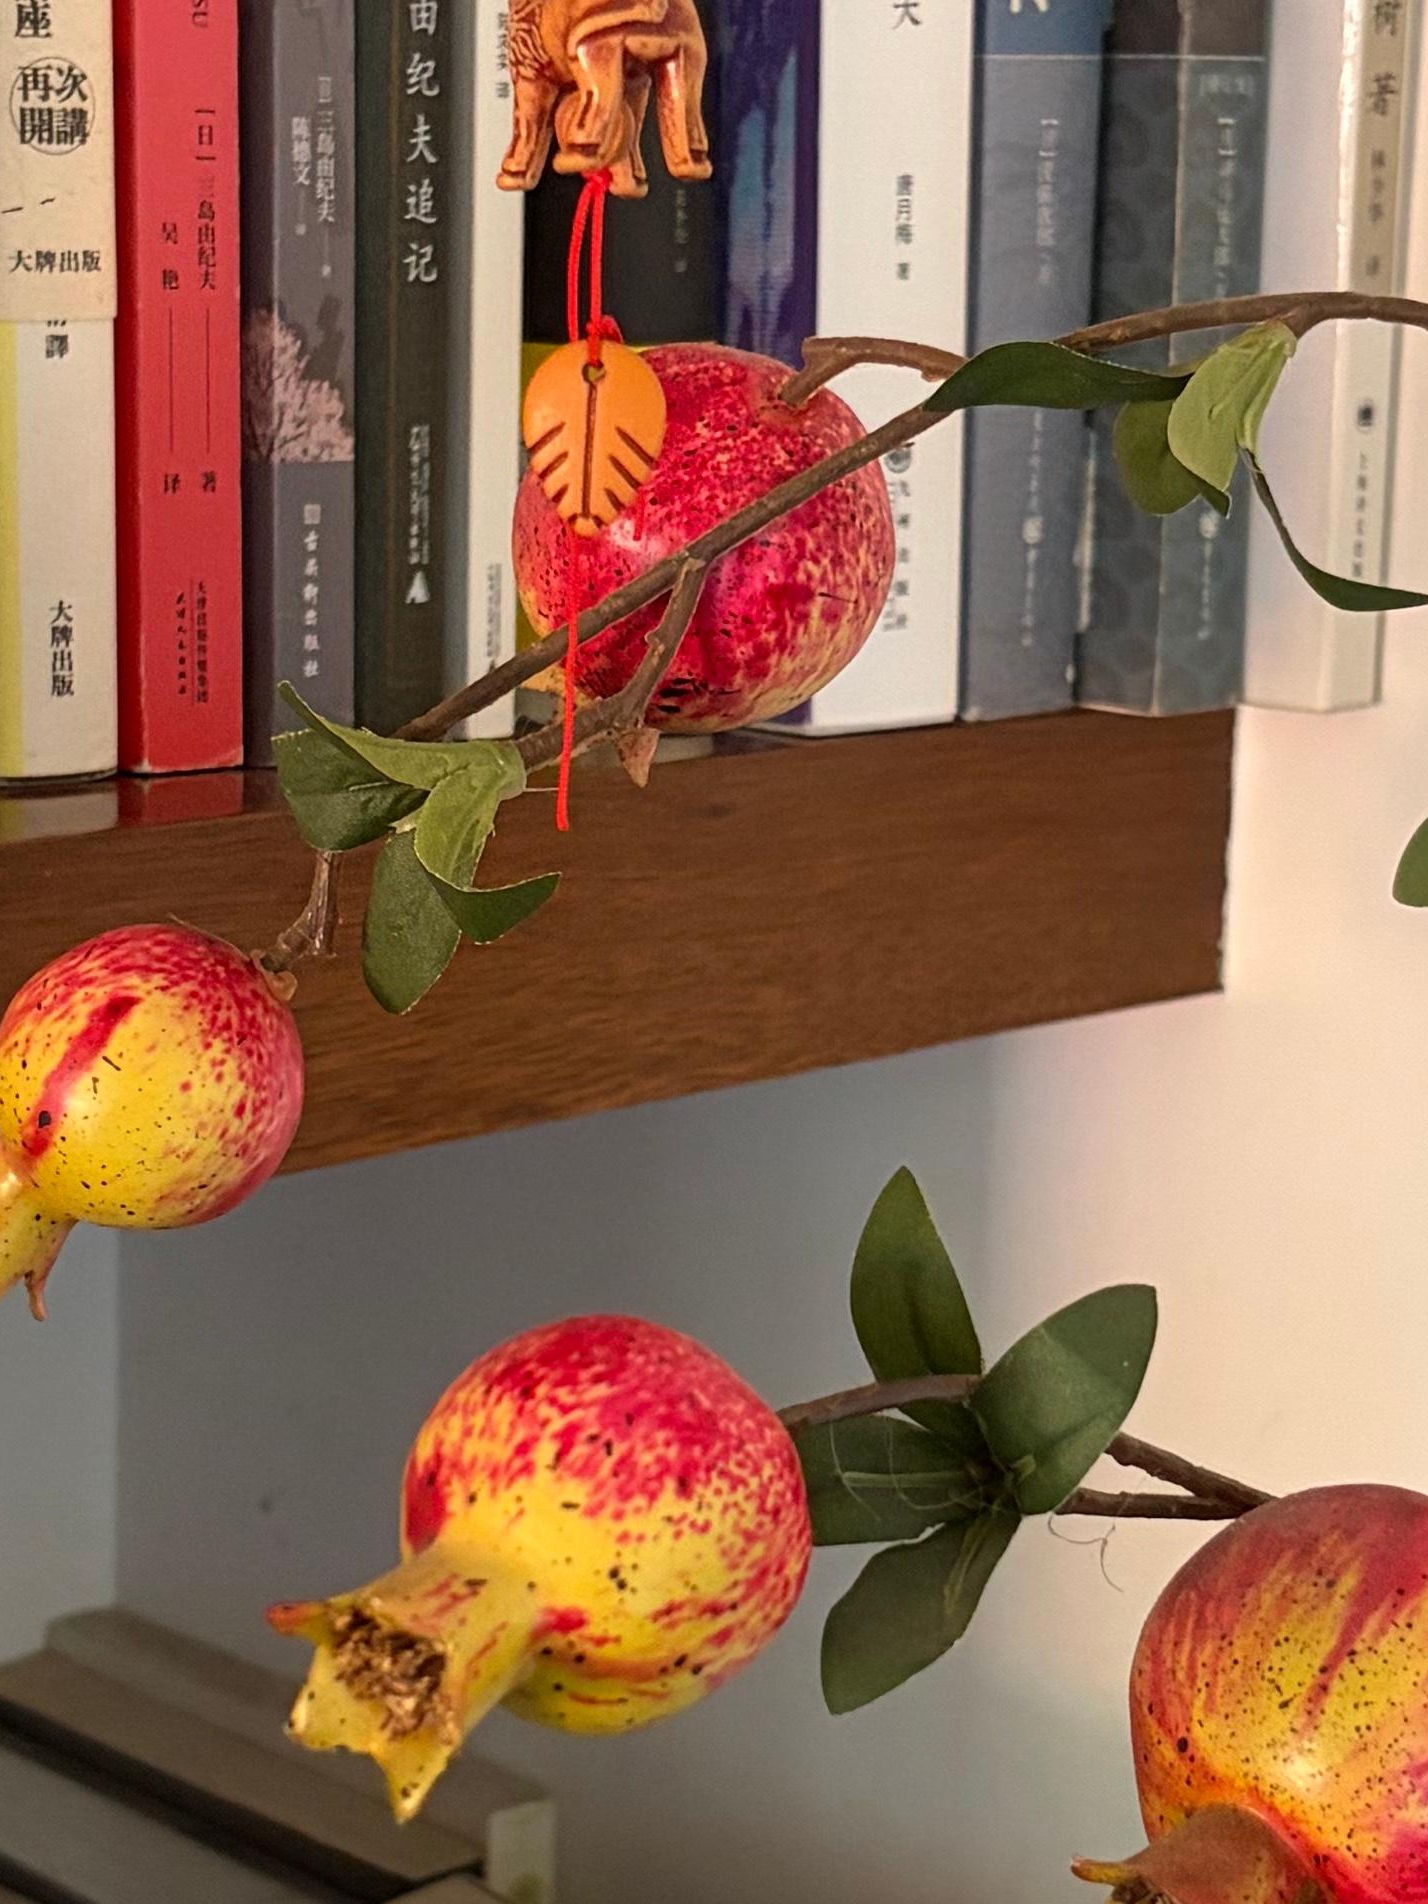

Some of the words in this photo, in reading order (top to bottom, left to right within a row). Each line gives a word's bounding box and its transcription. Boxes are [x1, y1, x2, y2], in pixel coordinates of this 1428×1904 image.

[8, 249, 102, 274] 大牌出版
[49, 599, 74, 696] 大牌出版
